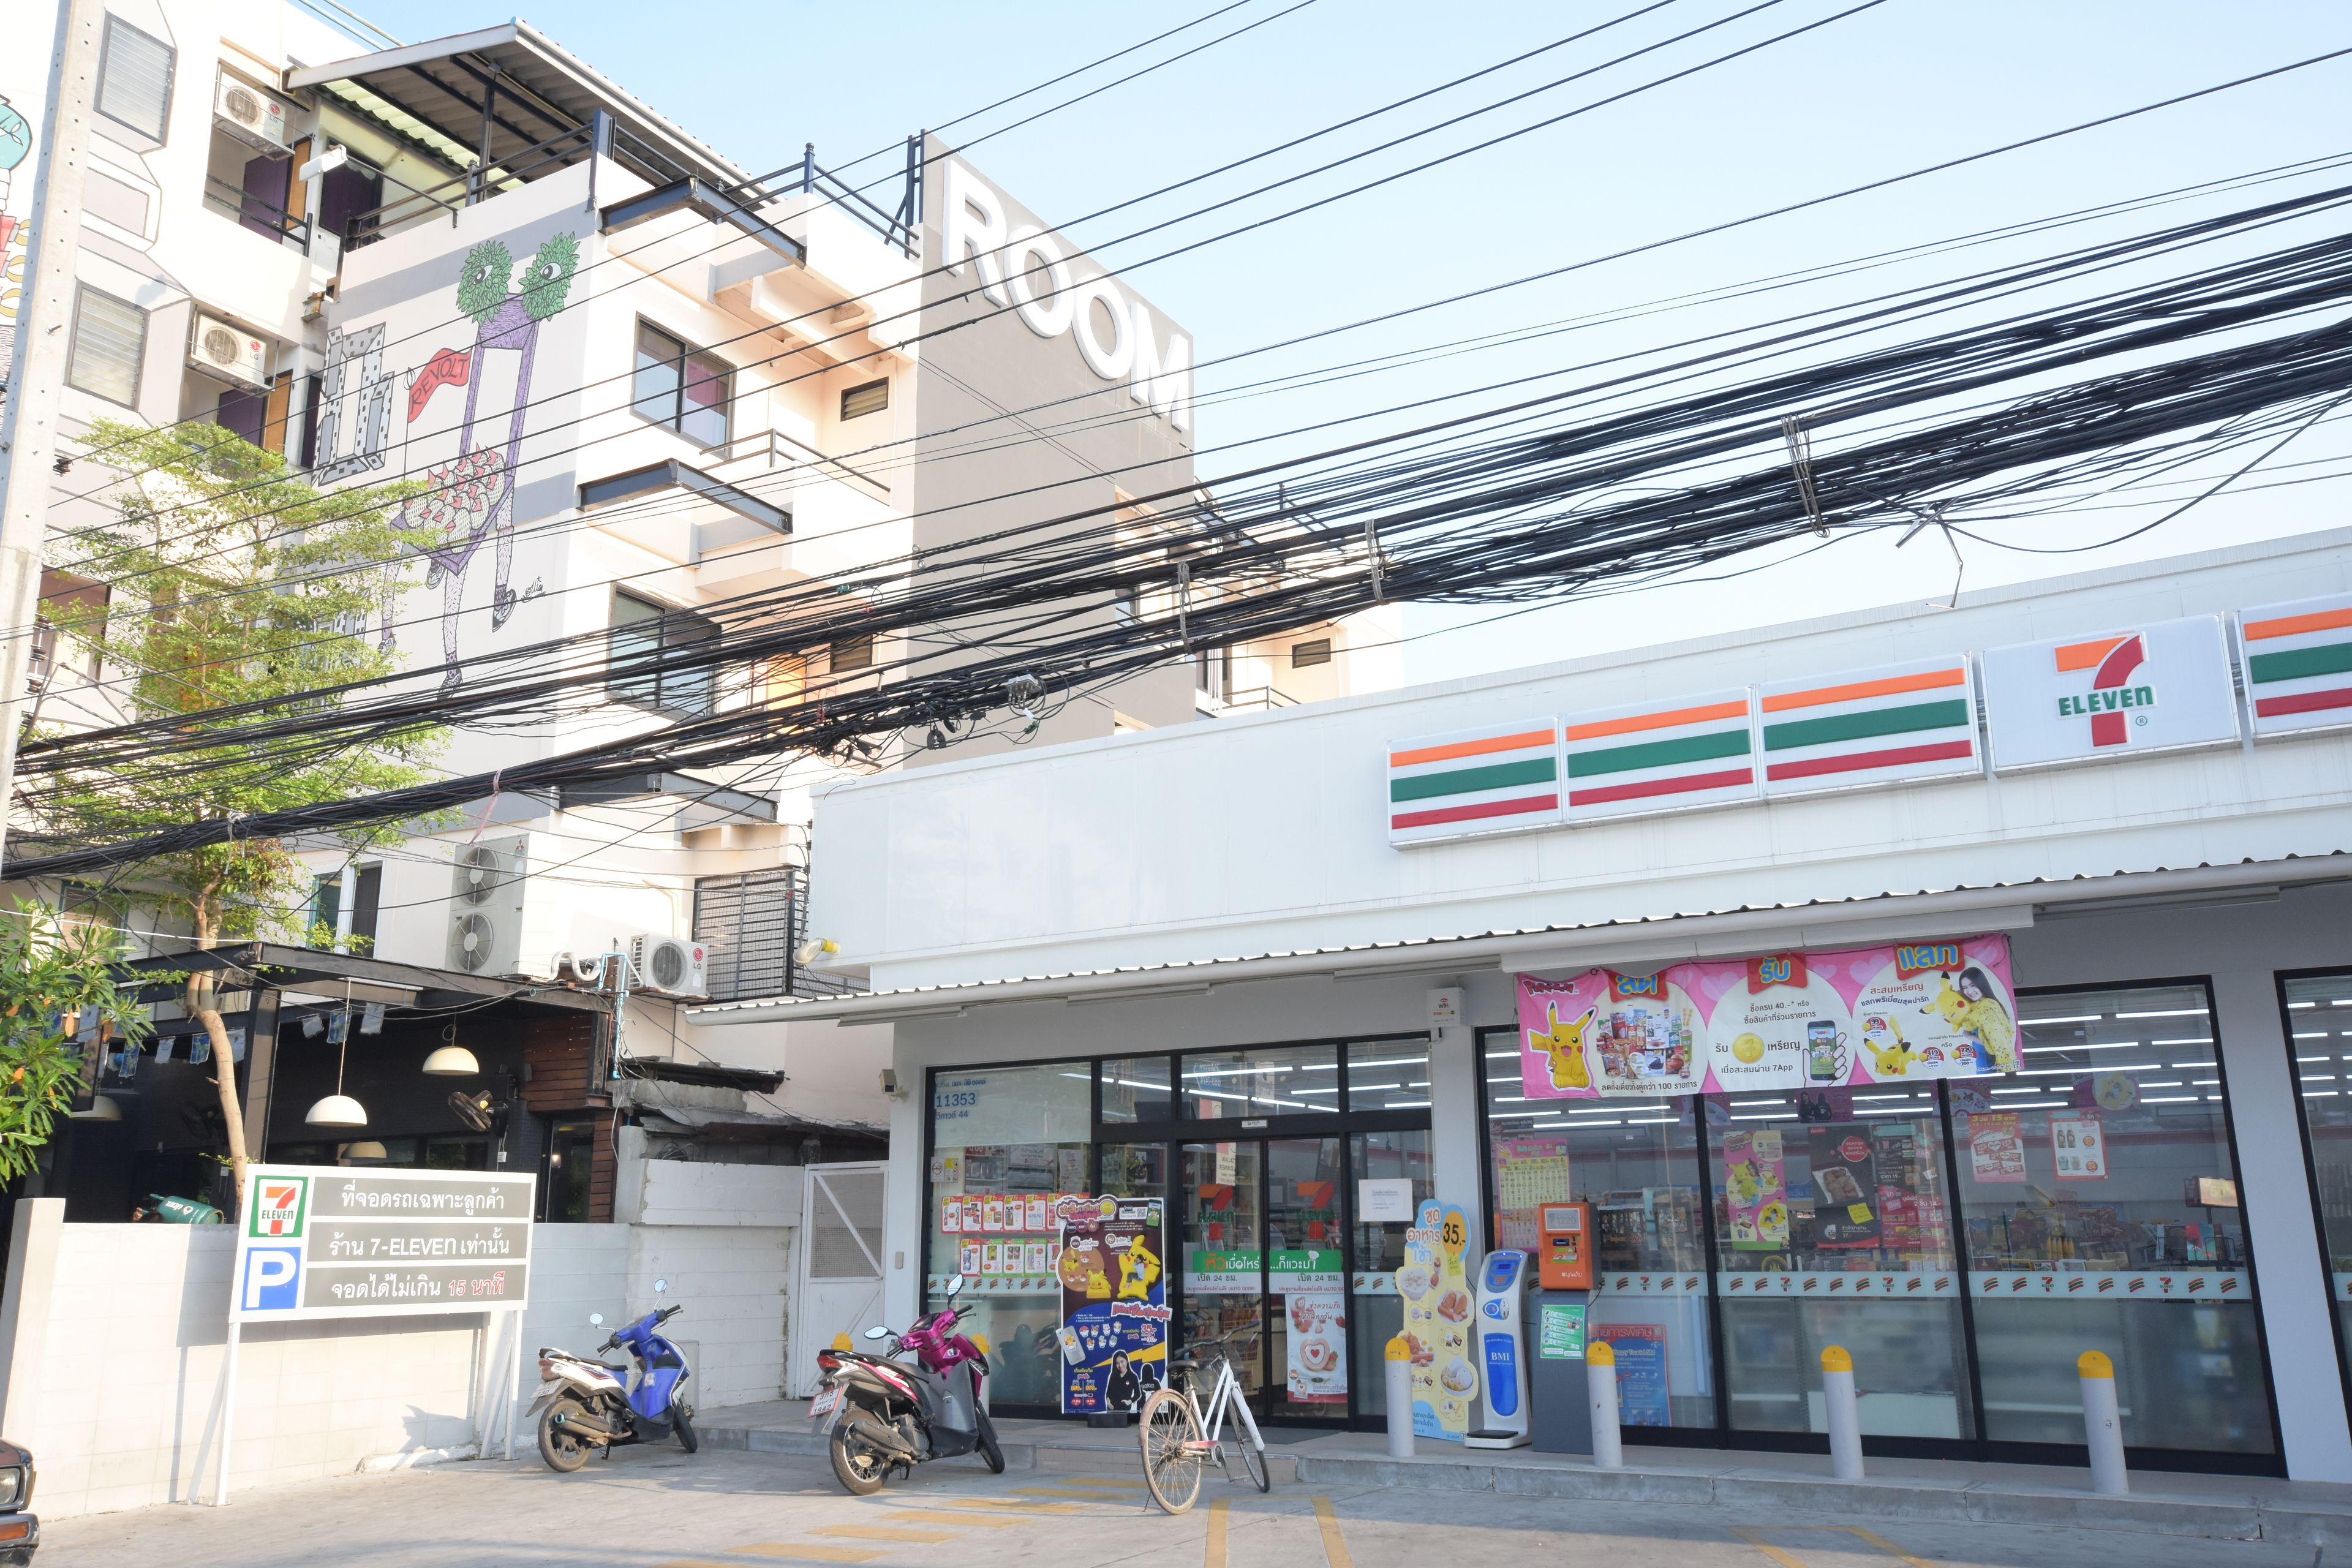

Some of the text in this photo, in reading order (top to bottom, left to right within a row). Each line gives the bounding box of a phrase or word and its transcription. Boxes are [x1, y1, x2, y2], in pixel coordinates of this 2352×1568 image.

[270, 115, 278, 123] LG
[943, 160, 1189, 432] ROOM
[250, 352, 259, 361] LG
[410, 356, 470, 415] REVOLT
[2055, 635, 2144, 747] 7
[1898, 944, 1958, 971] แลก
[1760, 957, 1791, 984] รับ
[1871, 982, 1924, 995] สะสมเหรียญ
[1750, 1003, 1773, 1012] ซื้อครบ
[1744, 1011, 1816, 1024] ซื้อสินค้าที่ร่วมรายการ
[1716, 1040, 1800, 1053] รับ เหรียญ
[1721, 1064, 1770, 1074] เมื่อสะสมผ่าน
[1675, 1080, 1697, 1088] รายการ
[937, 1093, 975, 1107] 11353
[342, 1180, 505, 1215] ที่จอดรถเฉพาะลูกค้า
[265, 1186, 296, 1234] 7
[1425, 1208, 1440, 1229] ชุด
[329, 1232, 364, 1256] ร้าน
[461, 1227, 510, 1254] เท่านั้น
[1408, 1229, 1440, 1242] อาหาร
[1443, 1223, 1466, 1246] 35.-
[1414, 1244, 1432, 1262] เช้า
[1205, 1253, 1260, 1270] หิวเมื่อไหร่
[246, 1251, 296, 1308] P
[1197, 1273, 1210, 1281] เปิด
[1298, 1272, 1311, 1281] เปิด
[331, 1271, 505, 1298] จอดได้ไม่เกิน 15 นาที
[1491, 1352, 1509, 1361] BMI
[814, 1404, 831, 1414] 1942
